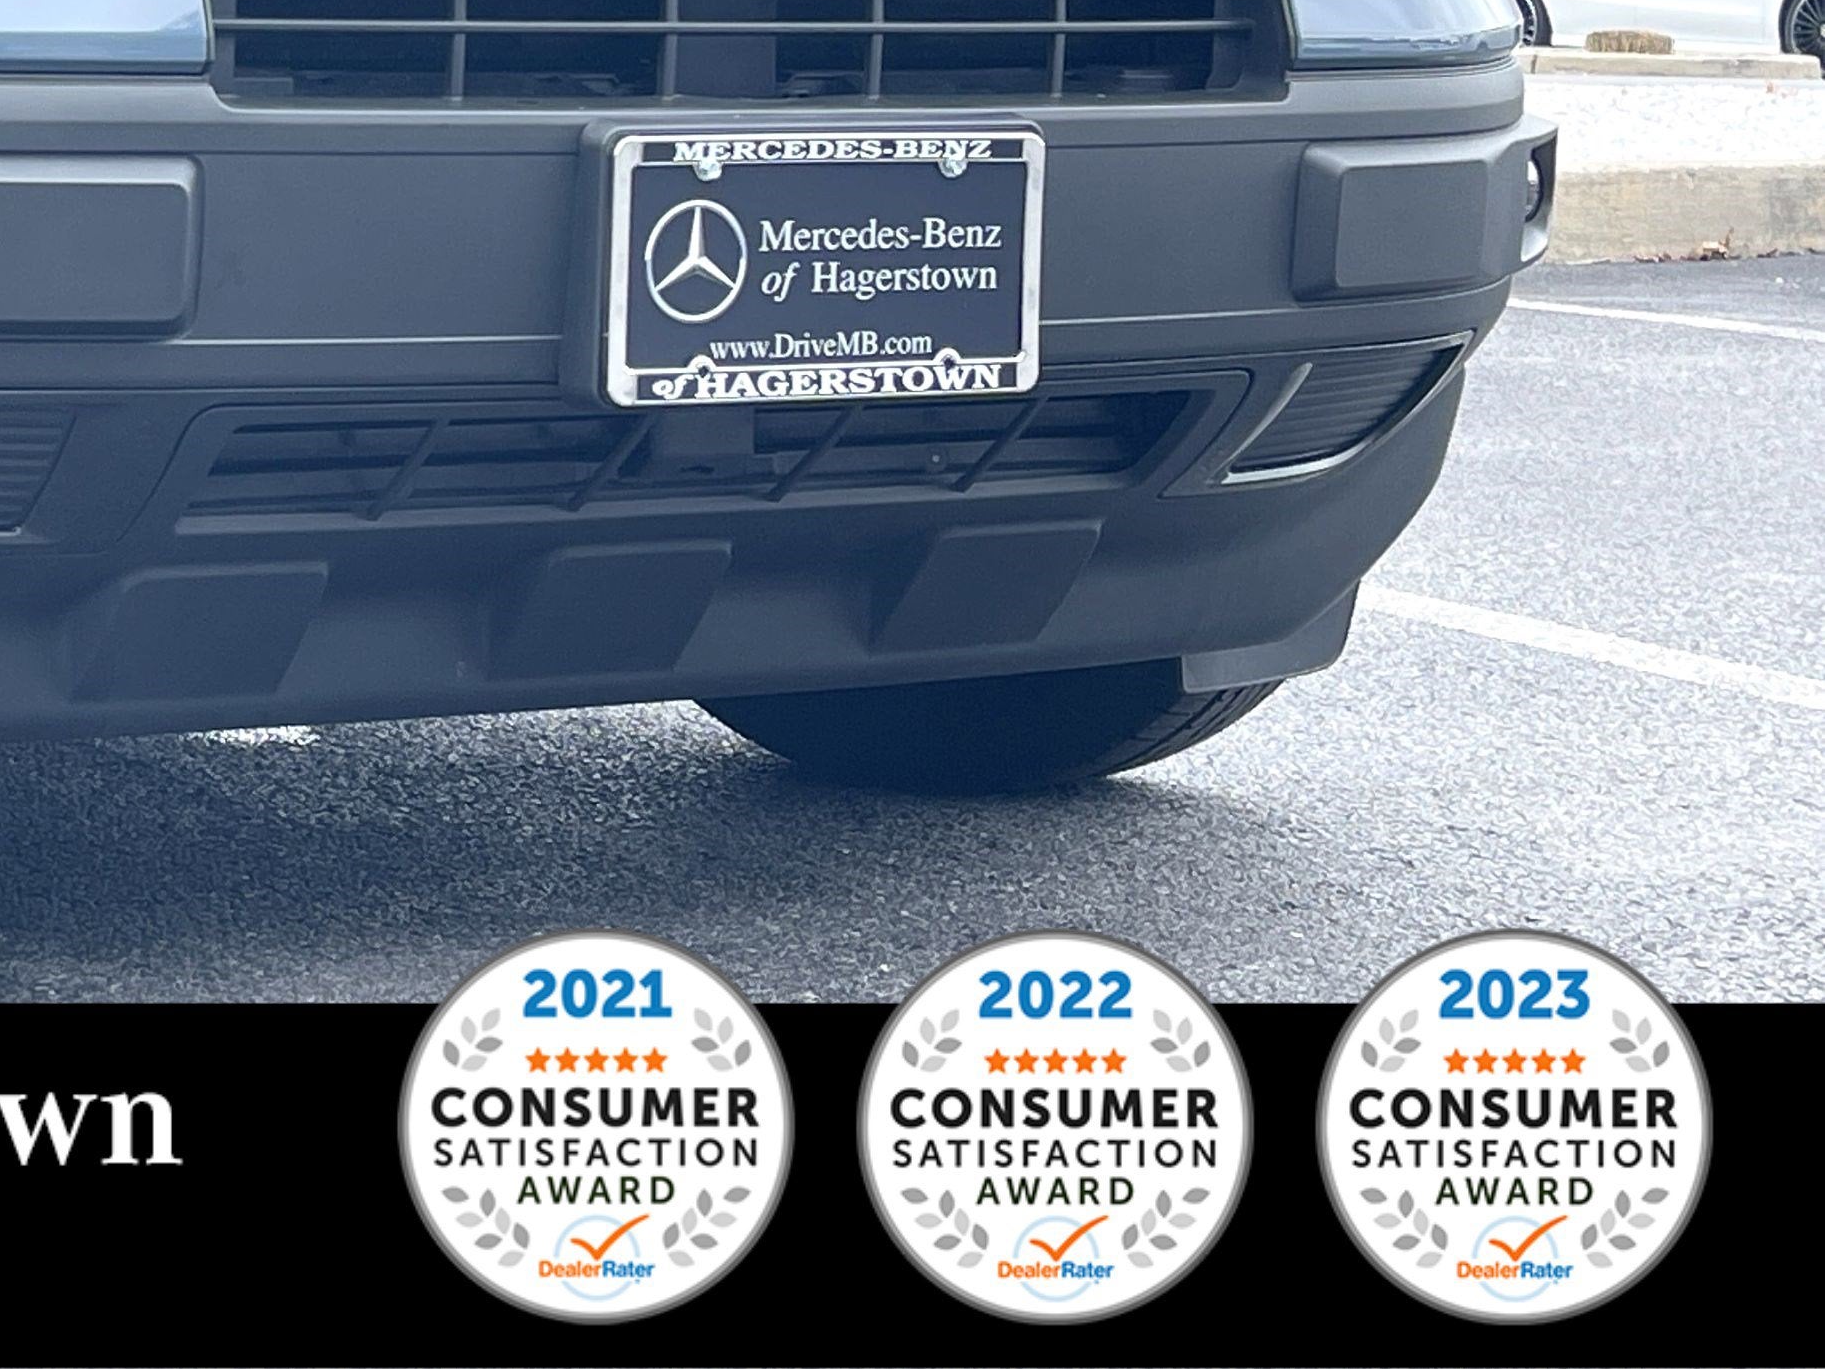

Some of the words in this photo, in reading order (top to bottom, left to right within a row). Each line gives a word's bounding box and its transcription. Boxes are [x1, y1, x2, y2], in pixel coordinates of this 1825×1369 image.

[672, 139, 992, 163] MERCEDES-BENZ
[758, 216, 1003, 253] Mercedes-Benz
[760, 261, 802, 302] of
[810, 259, 998, 301] Hagerstown
[709, 331, 933, 360] www.DriveMB.com
[651, 373, 691, 400] of
[693, 363, 1003, 400] HAGERSTOWN
